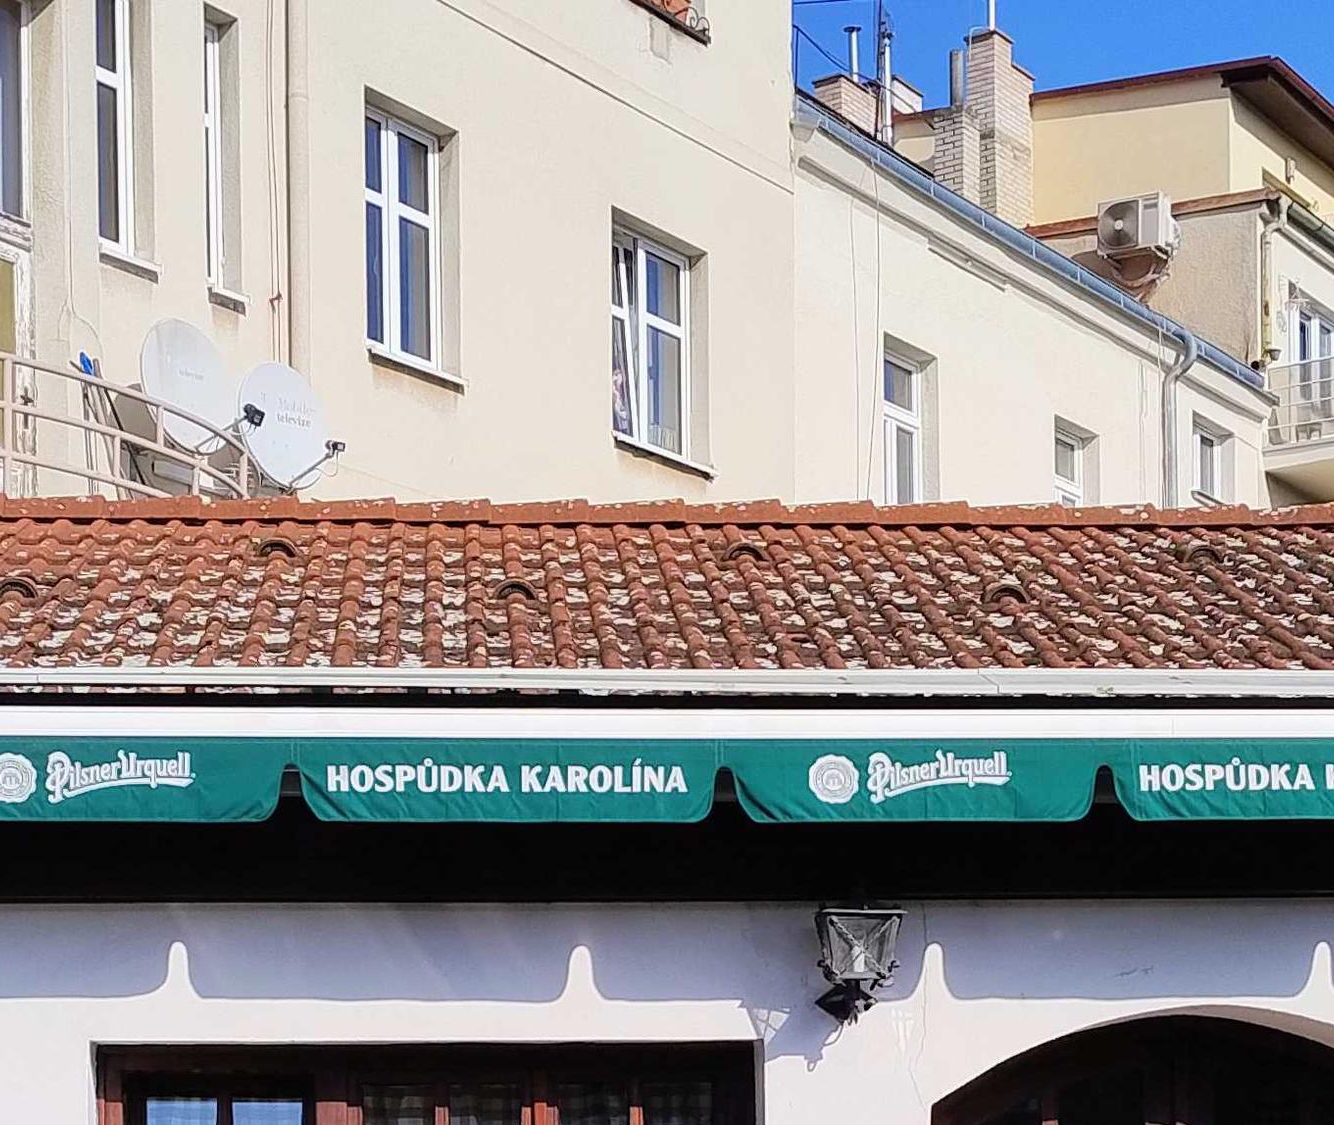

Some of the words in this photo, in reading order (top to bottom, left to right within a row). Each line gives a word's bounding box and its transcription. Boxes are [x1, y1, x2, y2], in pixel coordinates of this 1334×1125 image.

[47, 751, 121, 804] Pilsner
[117, 749, 191, 789] Urquell
[327, 757, 509, 793] HOSPŮDKA
[521, 757, 688, 793] KAROLÍNA
[868, 751, 940, 804] Pilsner
[935, 749, 1007, 788] Urquell
[1139, 757, 1315, 792] HOSPŮDKA
